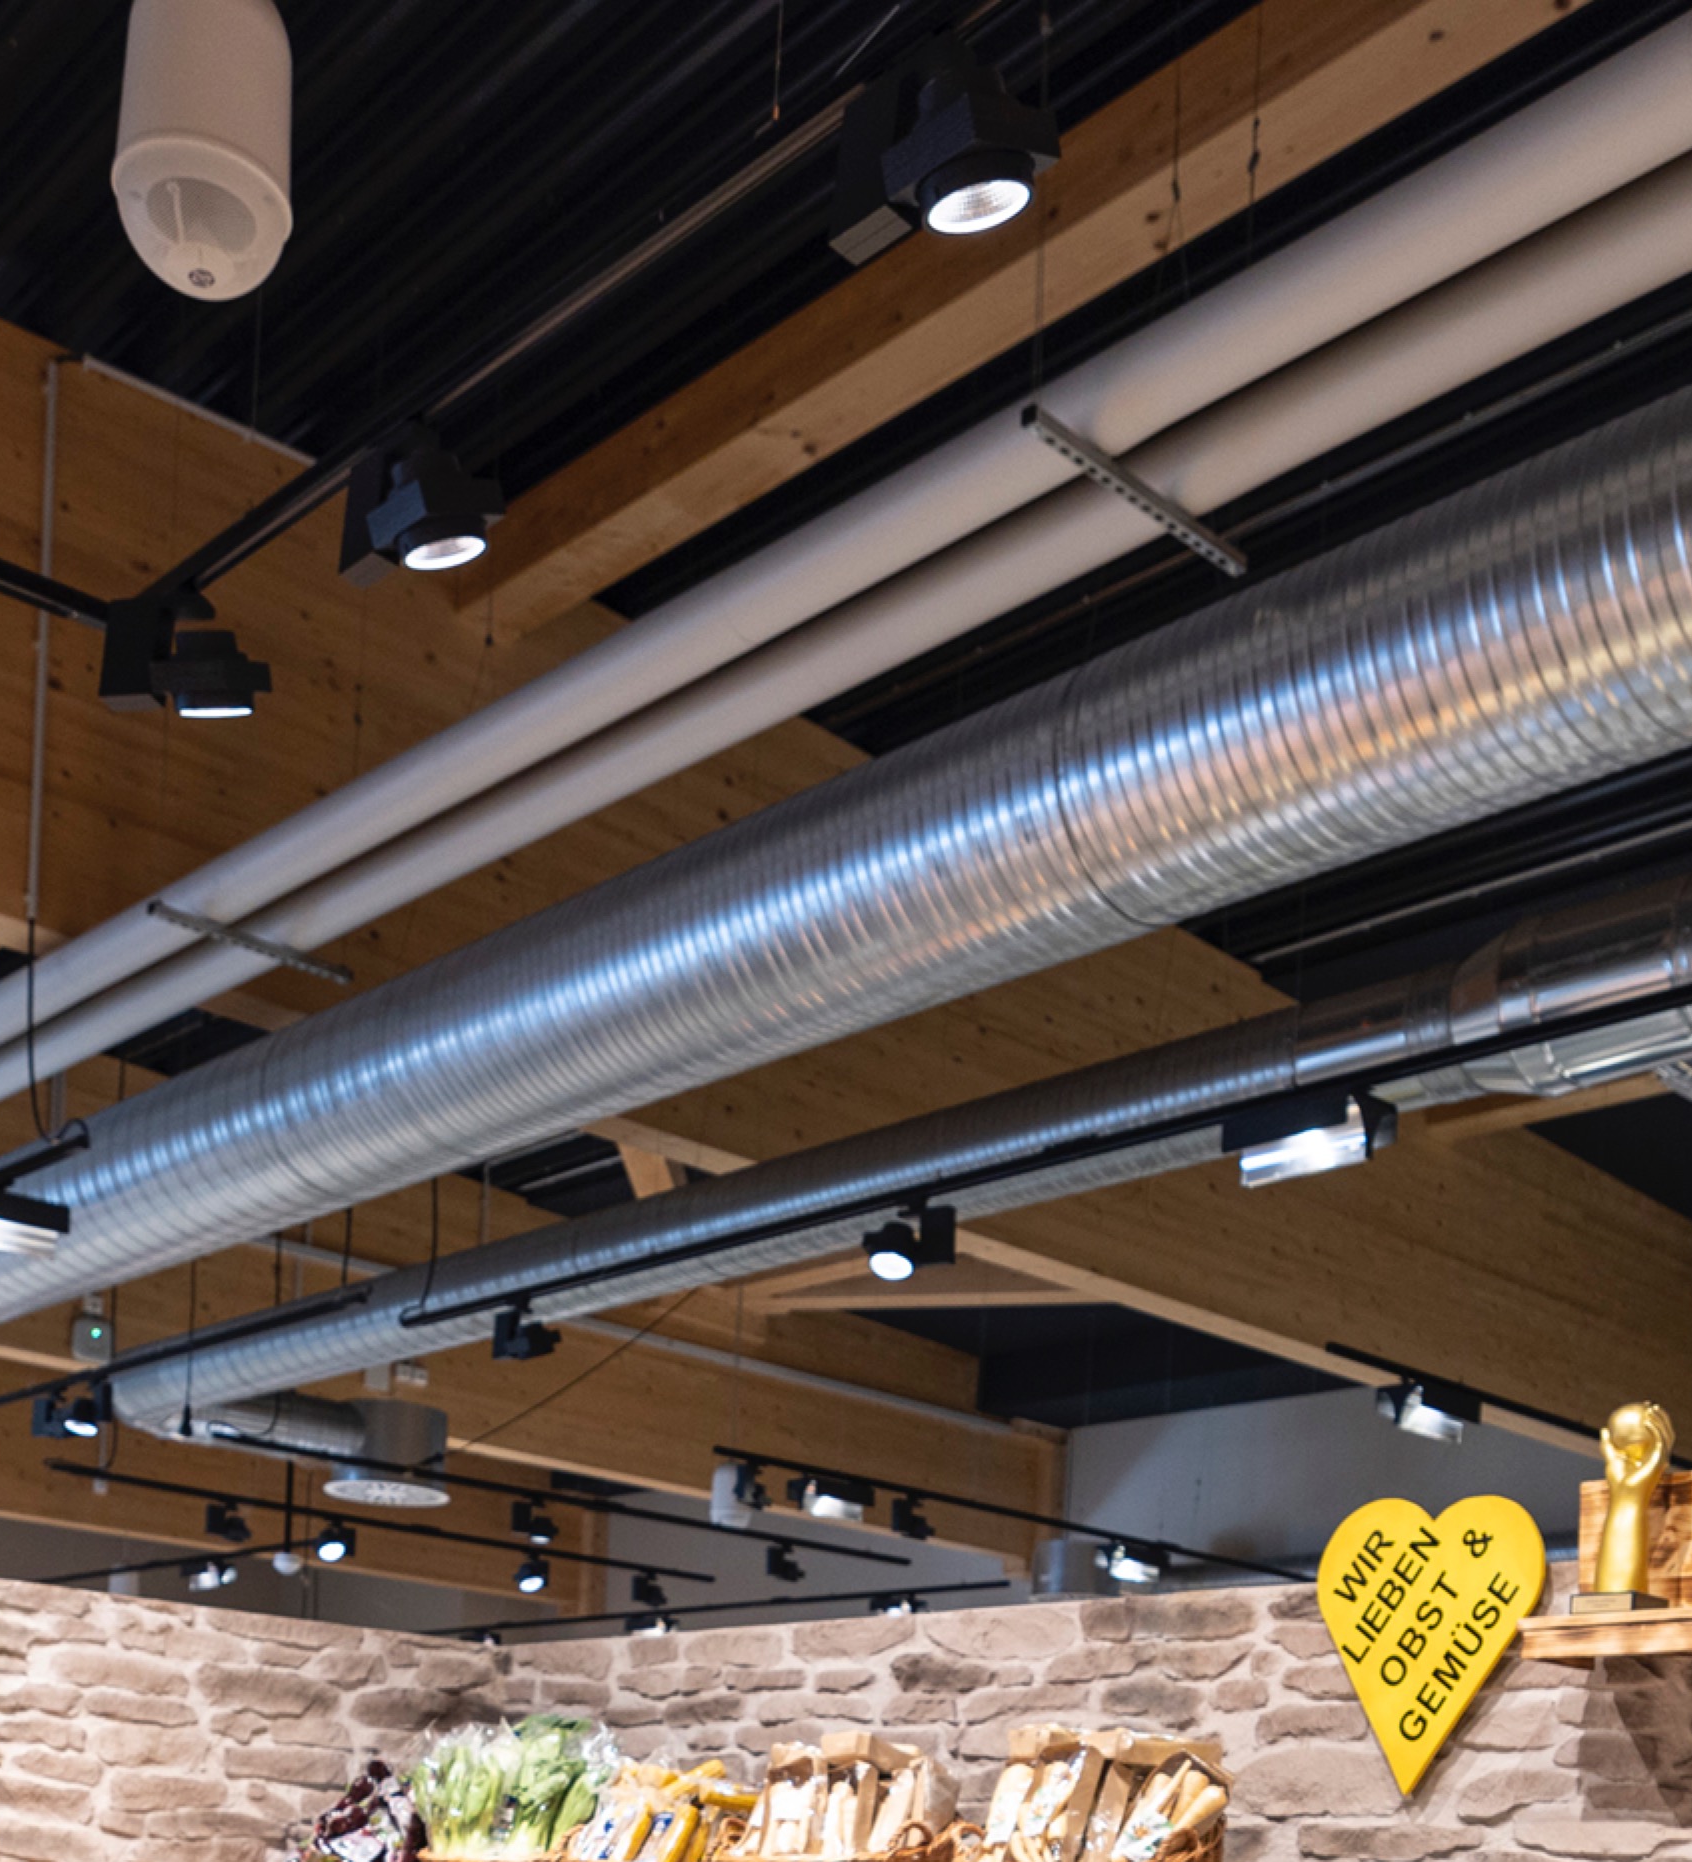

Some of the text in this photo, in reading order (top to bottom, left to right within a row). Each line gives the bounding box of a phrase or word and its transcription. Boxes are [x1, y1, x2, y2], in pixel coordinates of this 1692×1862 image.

[1333, 1529, 1395, 1604] WIR
[1341, 1526, 1440, 1665] LIEBEN
[1380, 1528, 1494, 1687] OBST &
[1399, 1571, 1521, 1742] GEMÜSE
